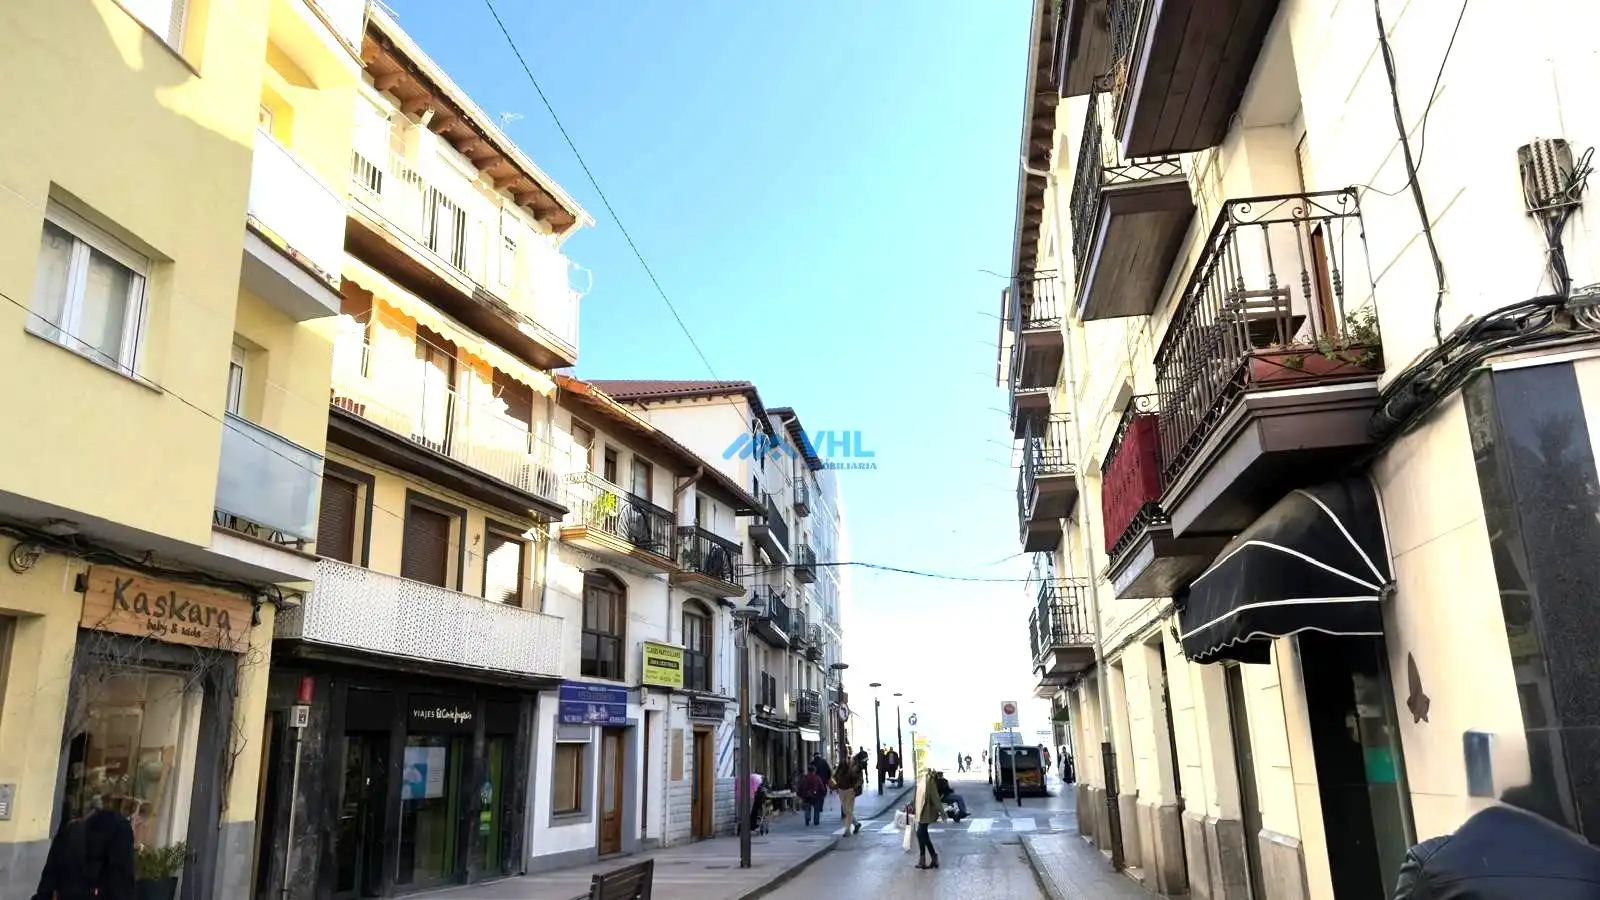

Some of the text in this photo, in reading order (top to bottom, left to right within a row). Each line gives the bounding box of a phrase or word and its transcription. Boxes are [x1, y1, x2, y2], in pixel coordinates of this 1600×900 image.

[112, 576, 231, 630] Kaskara
[146, 618, 201, 638] baby & kids
[413, 708, 435, 719] VIAJES
